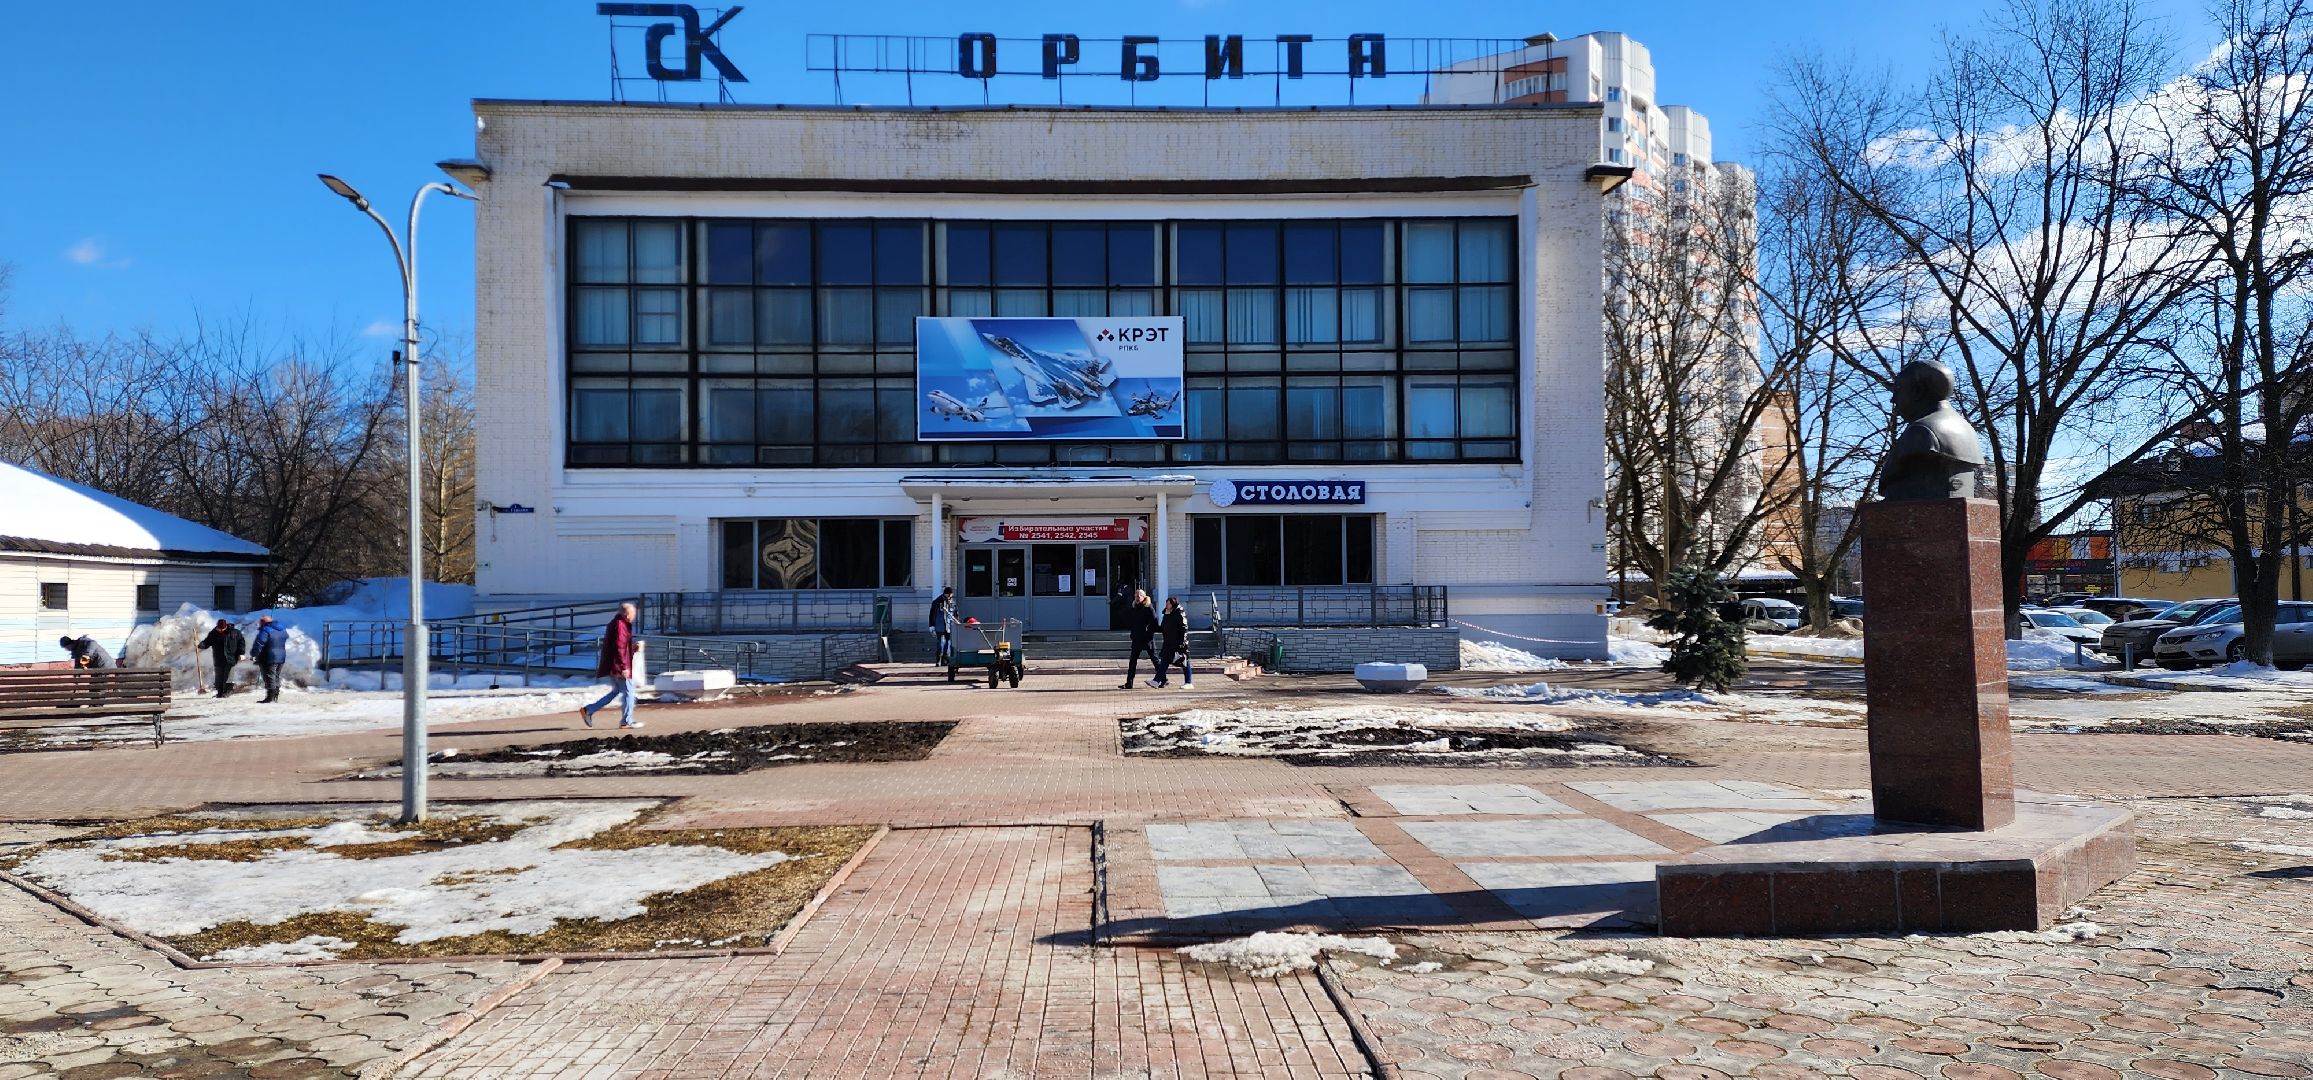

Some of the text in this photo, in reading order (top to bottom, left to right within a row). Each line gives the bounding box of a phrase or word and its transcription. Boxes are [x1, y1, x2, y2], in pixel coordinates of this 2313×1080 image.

[958, 31, 1387, 81] ОРБИТА
[1119, 328, 1169, 342] КРЭТ
[1240, 485, 1361, 500] СТОЛОВАЯ
[1008, 525, 1074, 533] Избирательные
